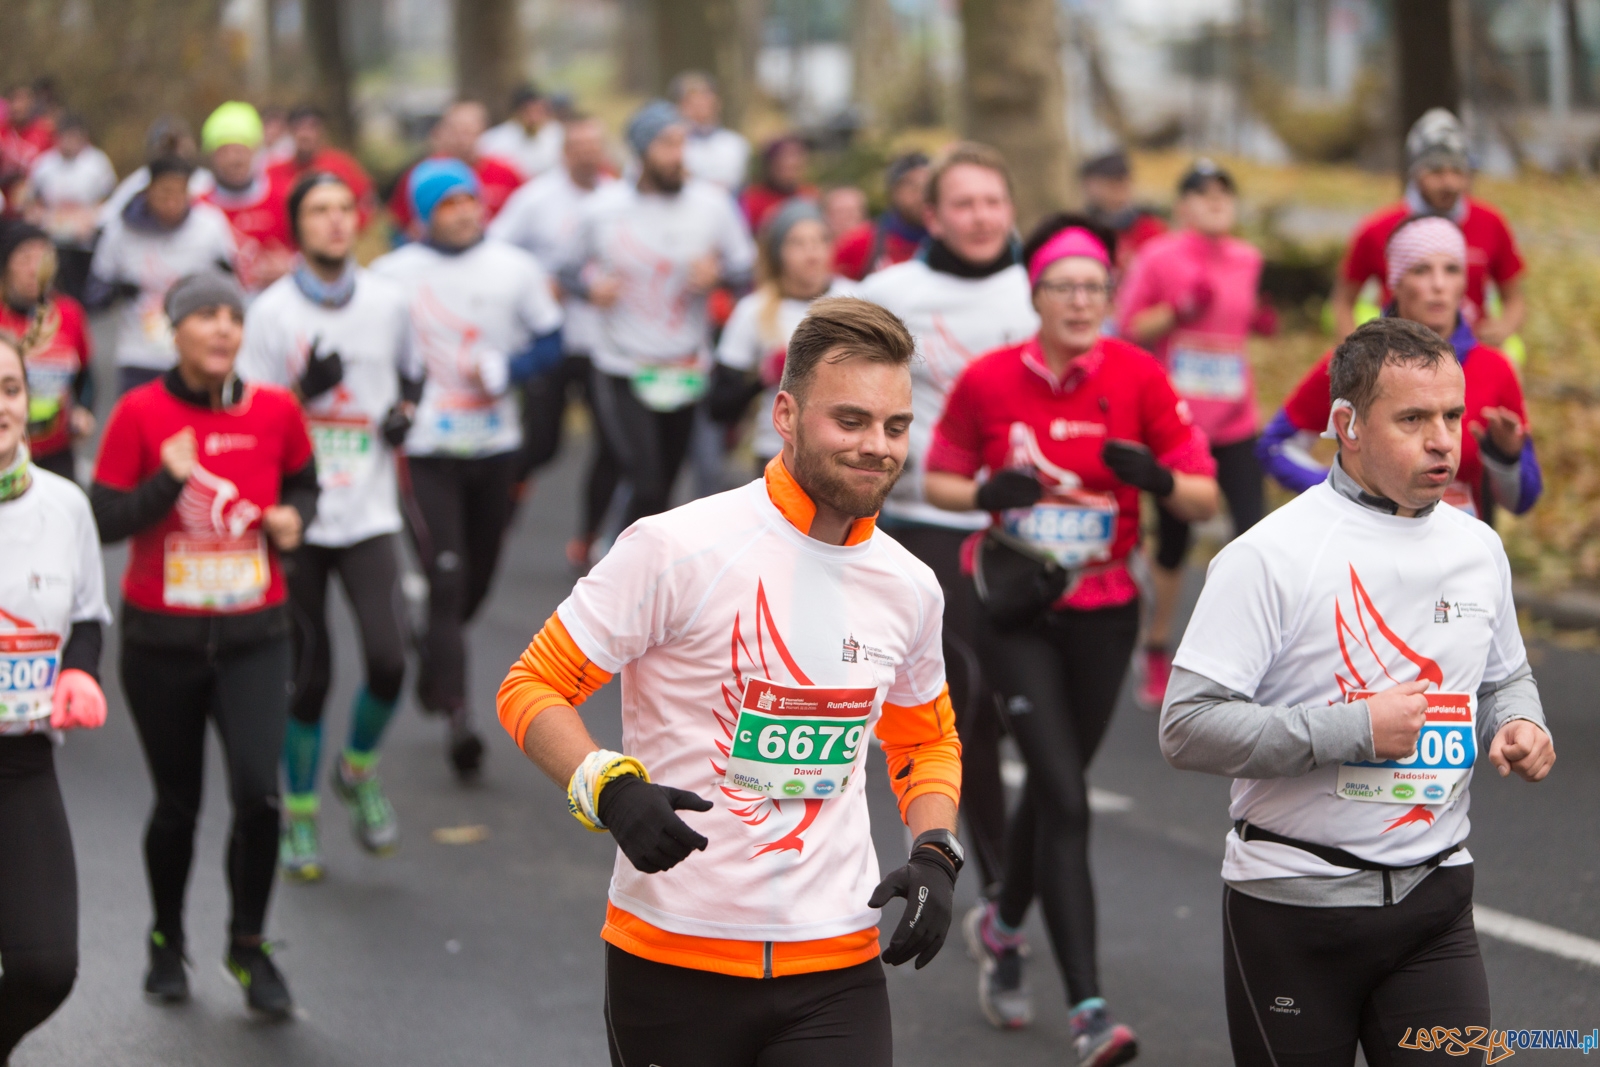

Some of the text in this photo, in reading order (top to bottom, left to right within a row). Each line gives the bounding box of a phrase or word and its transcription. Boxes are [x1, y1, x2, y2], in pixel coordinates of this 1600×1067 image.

[757, 724, 865, 761] 6679
[793, 767, 822, 776] Dawid
[734, 773, 760, 785] GRUPA
[733, 779, 763, 792] LUXMED
[1344, 788, 1374, 798] LUXMED
[1269, 1005, 1301, 1016] Kalenji
